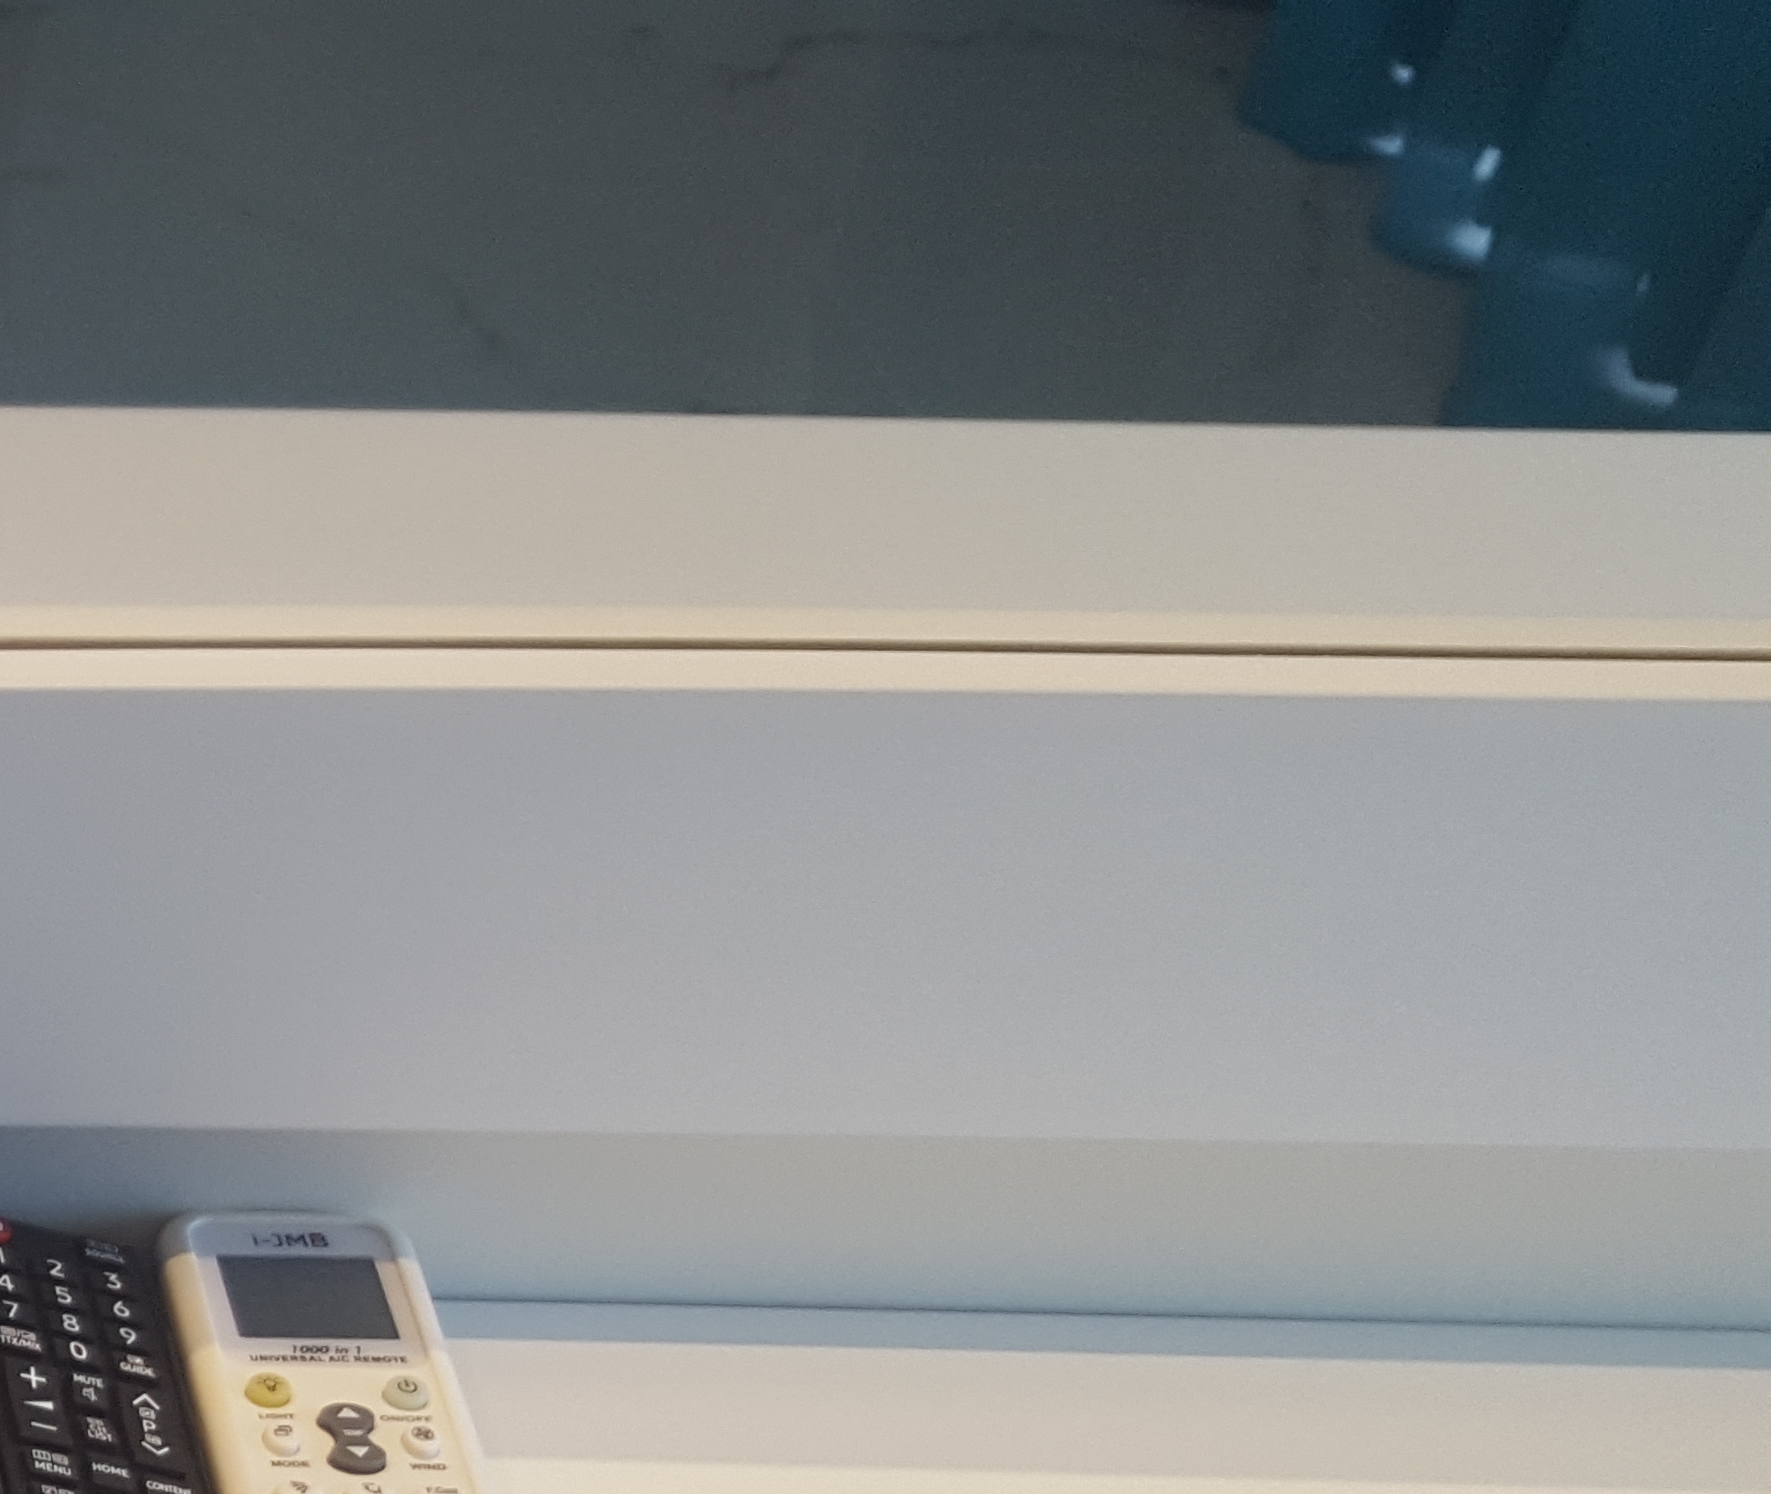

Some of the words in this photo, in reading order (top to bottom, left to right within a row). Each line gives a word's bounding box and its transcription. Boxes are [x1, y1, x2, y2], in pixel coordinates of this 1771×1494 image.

[47, 1258, 65, 1278] 2
[103, 1271, 122, 1289] 3
[55, 1285, 73, 1304] 5
[2, 1300, 18, 1318] 7
[113, 1300, 130, 1317] 6
[62, 1313, 80, 1332] 8
[119, 1327, 136, 1344] 9
[70, 1341, 87, 1360] 0
[292, 1345, 330, 1354] 1000
[249, 1354, 325, 1363] UNIVERSAL
[353, 1355, 409, 1364] REMOTE
[120, 1361, 156, 1378] GUIDE
[73, 1373, 104, 1388] MUTE
[143, 1419, 156, 1432] P
[87, 1429, 113, 1443] LIST
[34, 1460, 72, 1476] MENU
[92, 1462, 130, 1478] HOME
[270, 1459, 311, 1468] MODE
